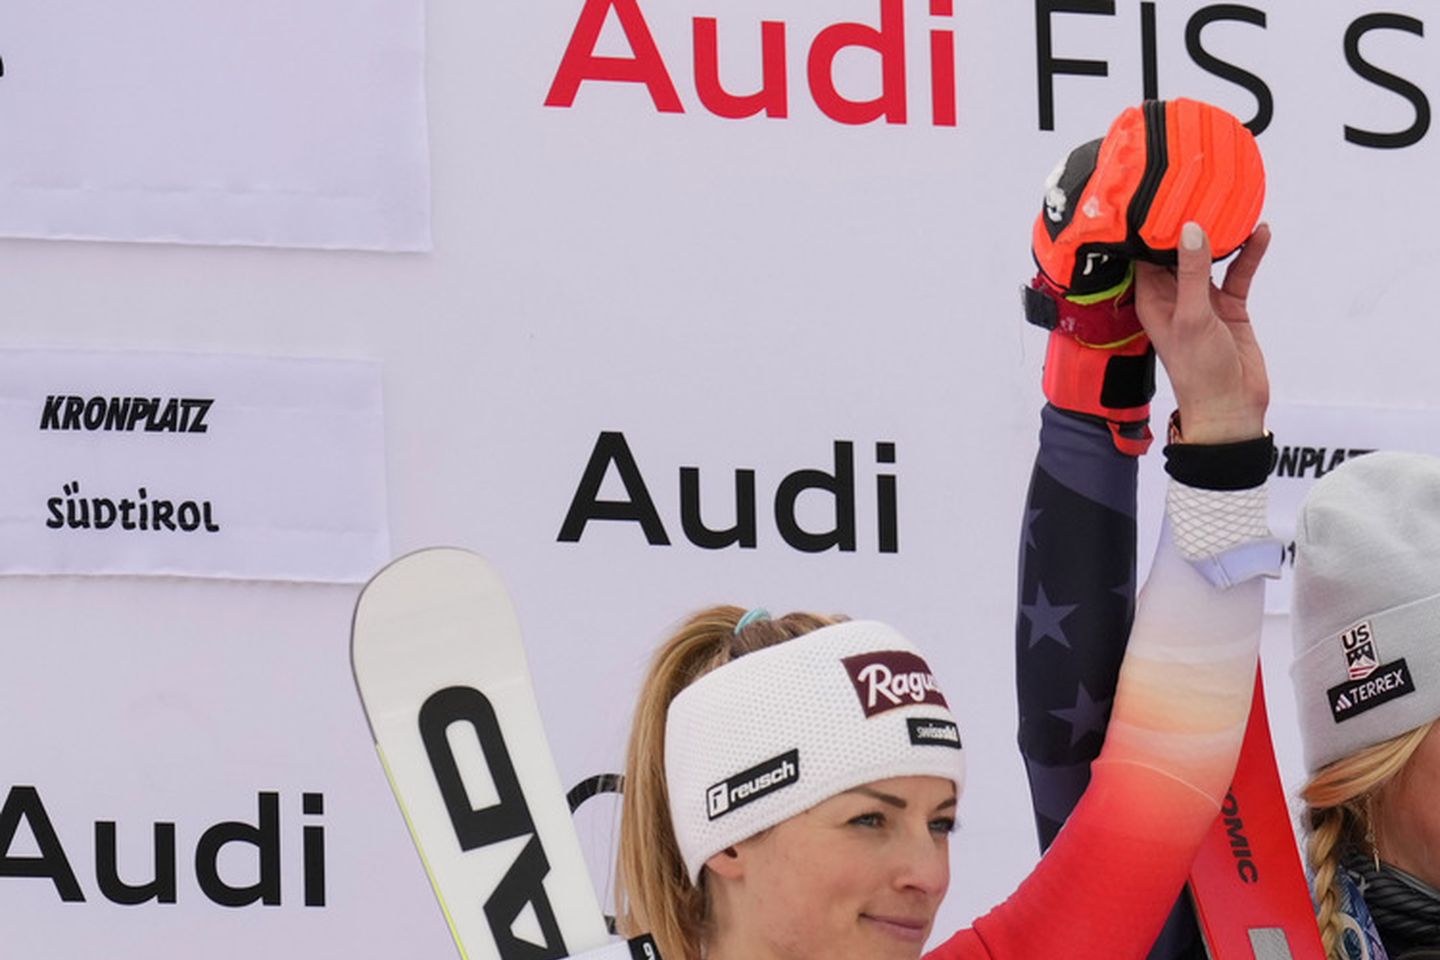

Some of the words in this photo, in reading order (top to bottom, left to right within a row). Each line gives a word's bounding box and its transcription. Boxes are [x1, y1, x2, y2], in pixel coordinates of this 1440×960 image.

[543, 0, 957, 127] Audi
[1035, 0, 1274, 136] FIS
[40, 396, 214, 433] KRONPLATZ
[556, 430, 900, 554] Audi
[1342, 624, 1371, 651] US
[1349, 669, 1405, 704] TERREX
[730, 760, 796, 804] reusch
[0, 785, 326, 908] Audi
